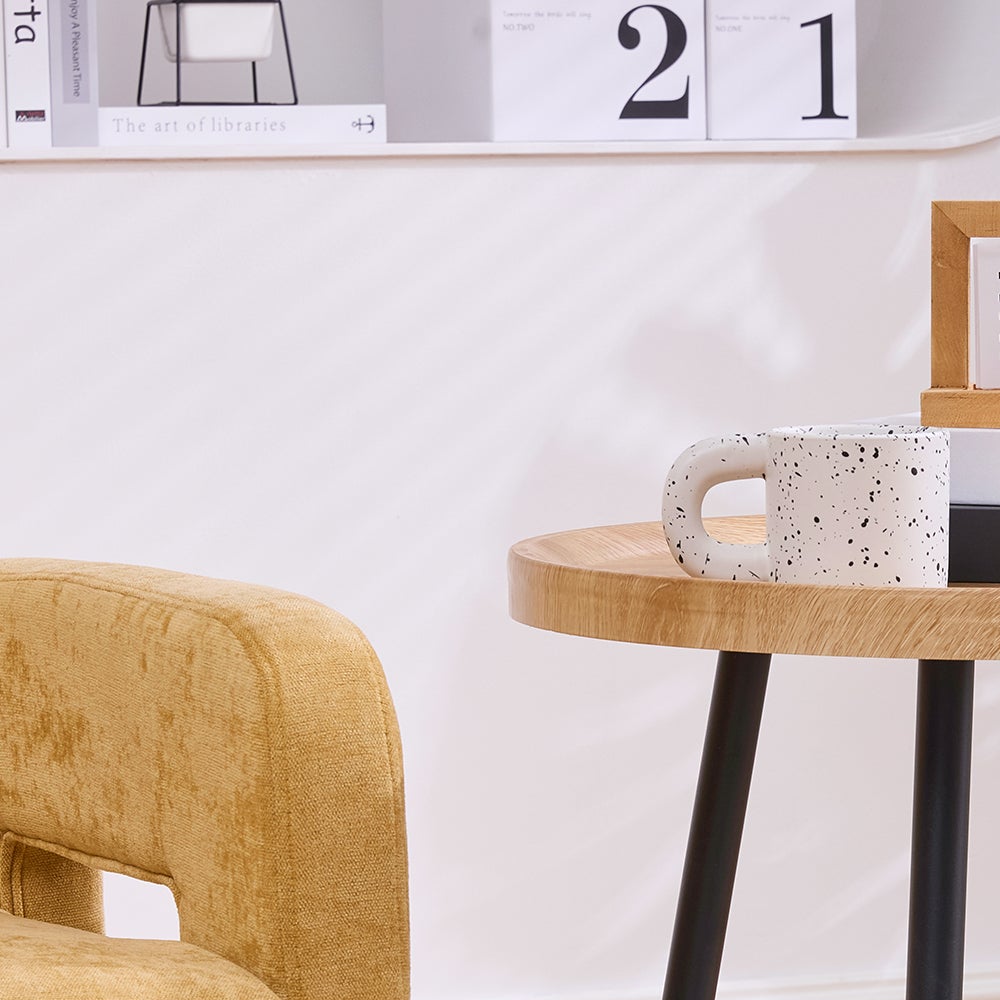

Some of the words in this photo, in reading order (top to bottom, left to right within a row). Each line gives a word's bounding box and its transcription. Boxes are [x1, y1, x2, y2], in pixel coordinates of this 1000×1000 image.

[13, 0, 41, 44] ta
[72, 31, 81, 71] Pleasant
[617, 4, 690, 119] 2
[800, 13, 849, 120] 1
[73, 73, 82, 97] Time
[113, 117, 146, 133] The
[154, 120, 178, 133] art
[186, 116, 206, 132] of
[211, 116, 287, 132] libraries
